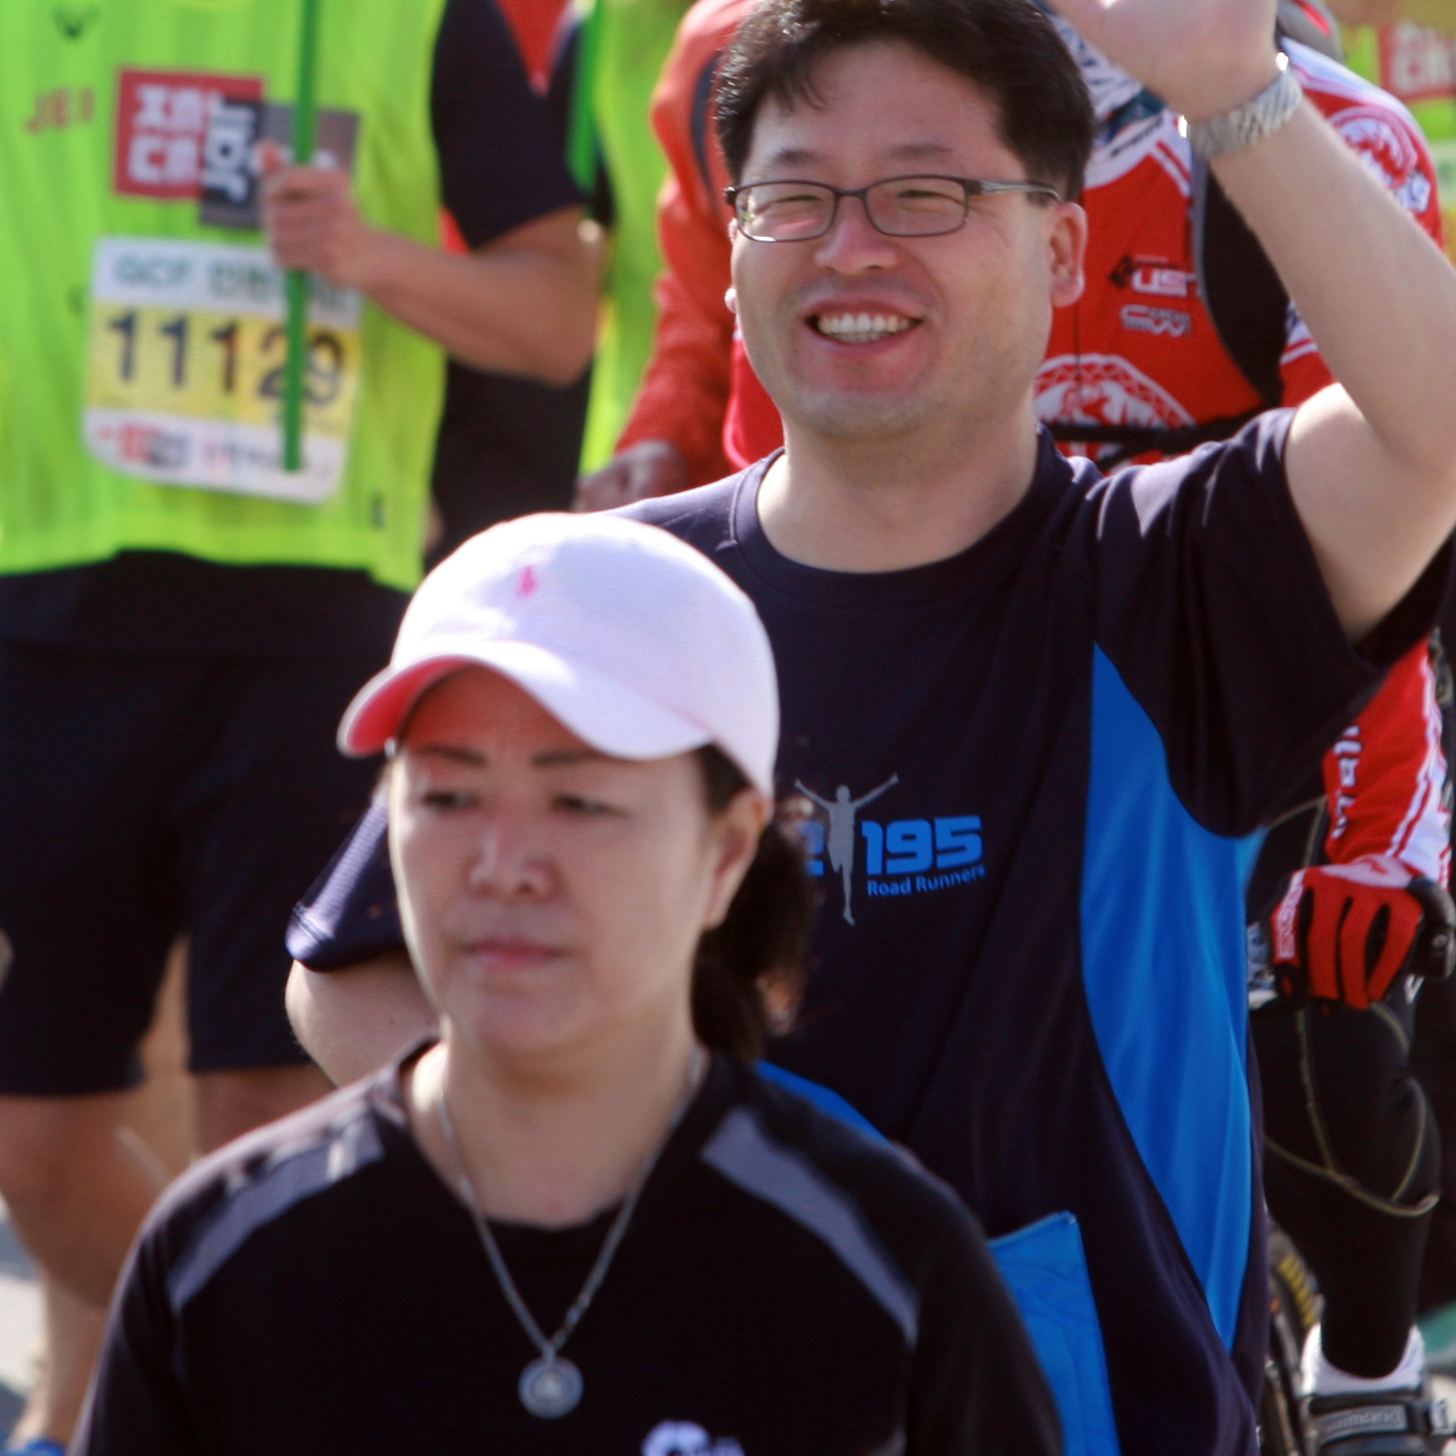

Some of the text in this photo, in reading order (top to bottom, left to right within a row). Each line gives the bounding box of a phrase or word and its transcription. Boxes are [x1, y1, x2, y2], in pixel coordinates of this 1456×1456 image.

[861, 814, 985, 876] 195
[866, 863, 987, 897] Road Runners
